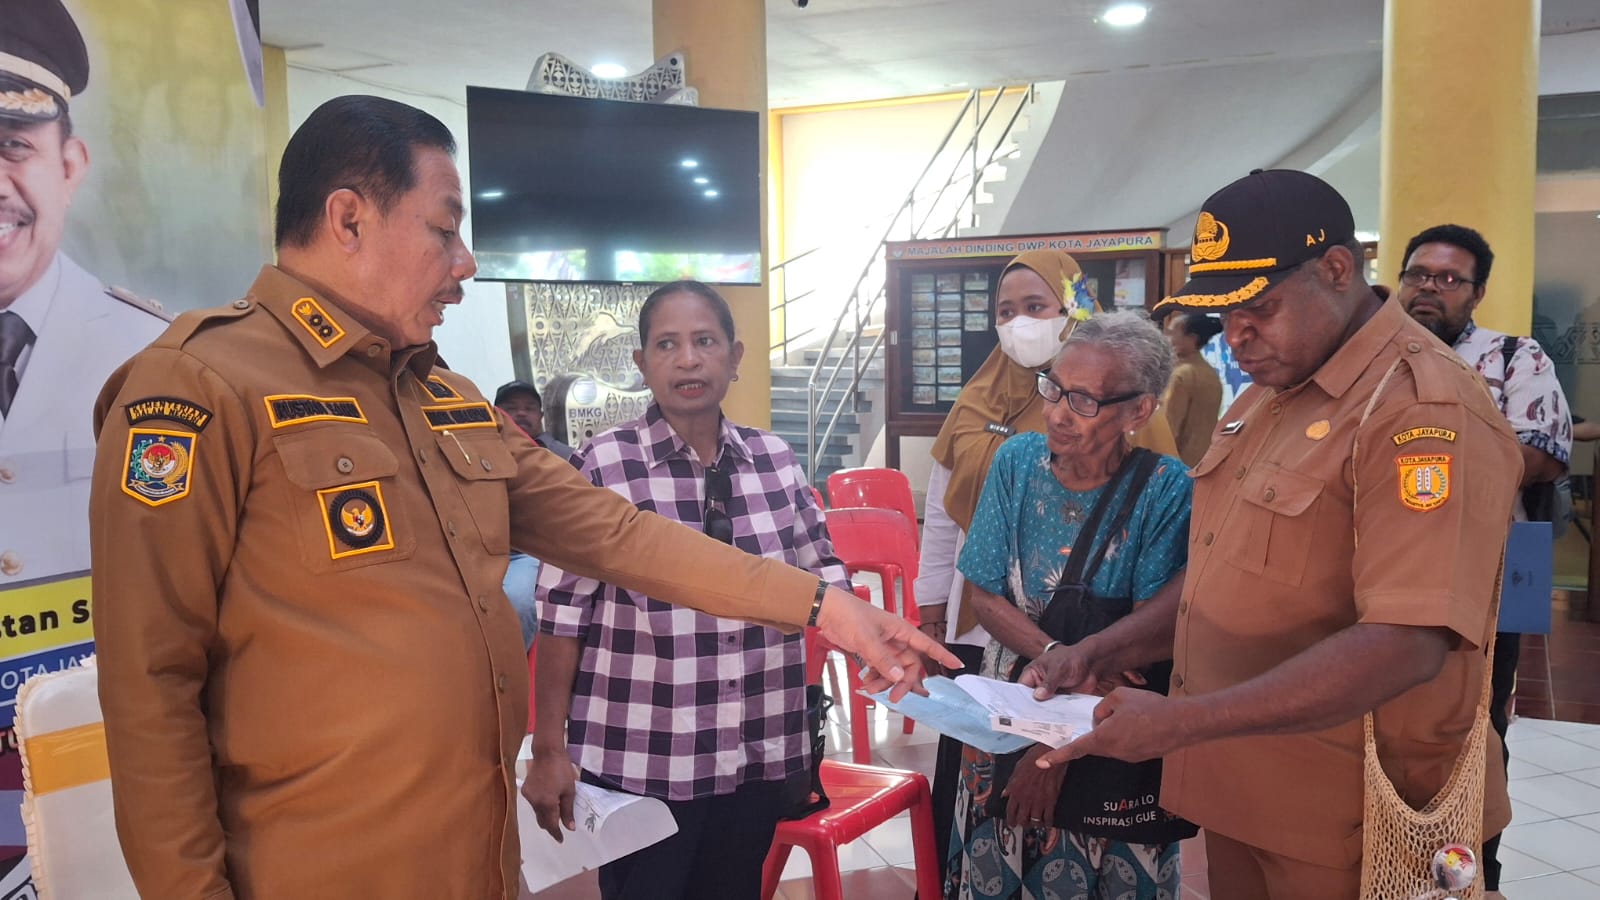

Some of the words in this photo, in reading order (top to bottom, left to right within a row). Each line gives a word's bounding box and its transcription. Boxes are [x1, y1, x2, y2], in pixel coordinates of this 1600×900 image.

[908, 246, 962, 257] MAJALAH
[965, 243, 1014, 254] DINDING
[1018, 241, 1045, 251] DWP
[1049, 239, 1082, 249] KOTA
[1086, 236, 1153, 248] JAYAPURA
[569, 408, 602, 418] BMKG
[1397, 431, 1416, 441] KOTA
[1417, 428, 1452, 438] JAYAPURA
[0, 610, 59, 639] tan
[72, 599, 90, 624] S
[0, 663, 48, 689] OTA
[1103, 798, 1140, 812] SUARA
[1141, 794, 1155, 806] LO
[1083, 815, 1133, 827] INSPIRASI
[1135, 810, 1157, 824] GUE
